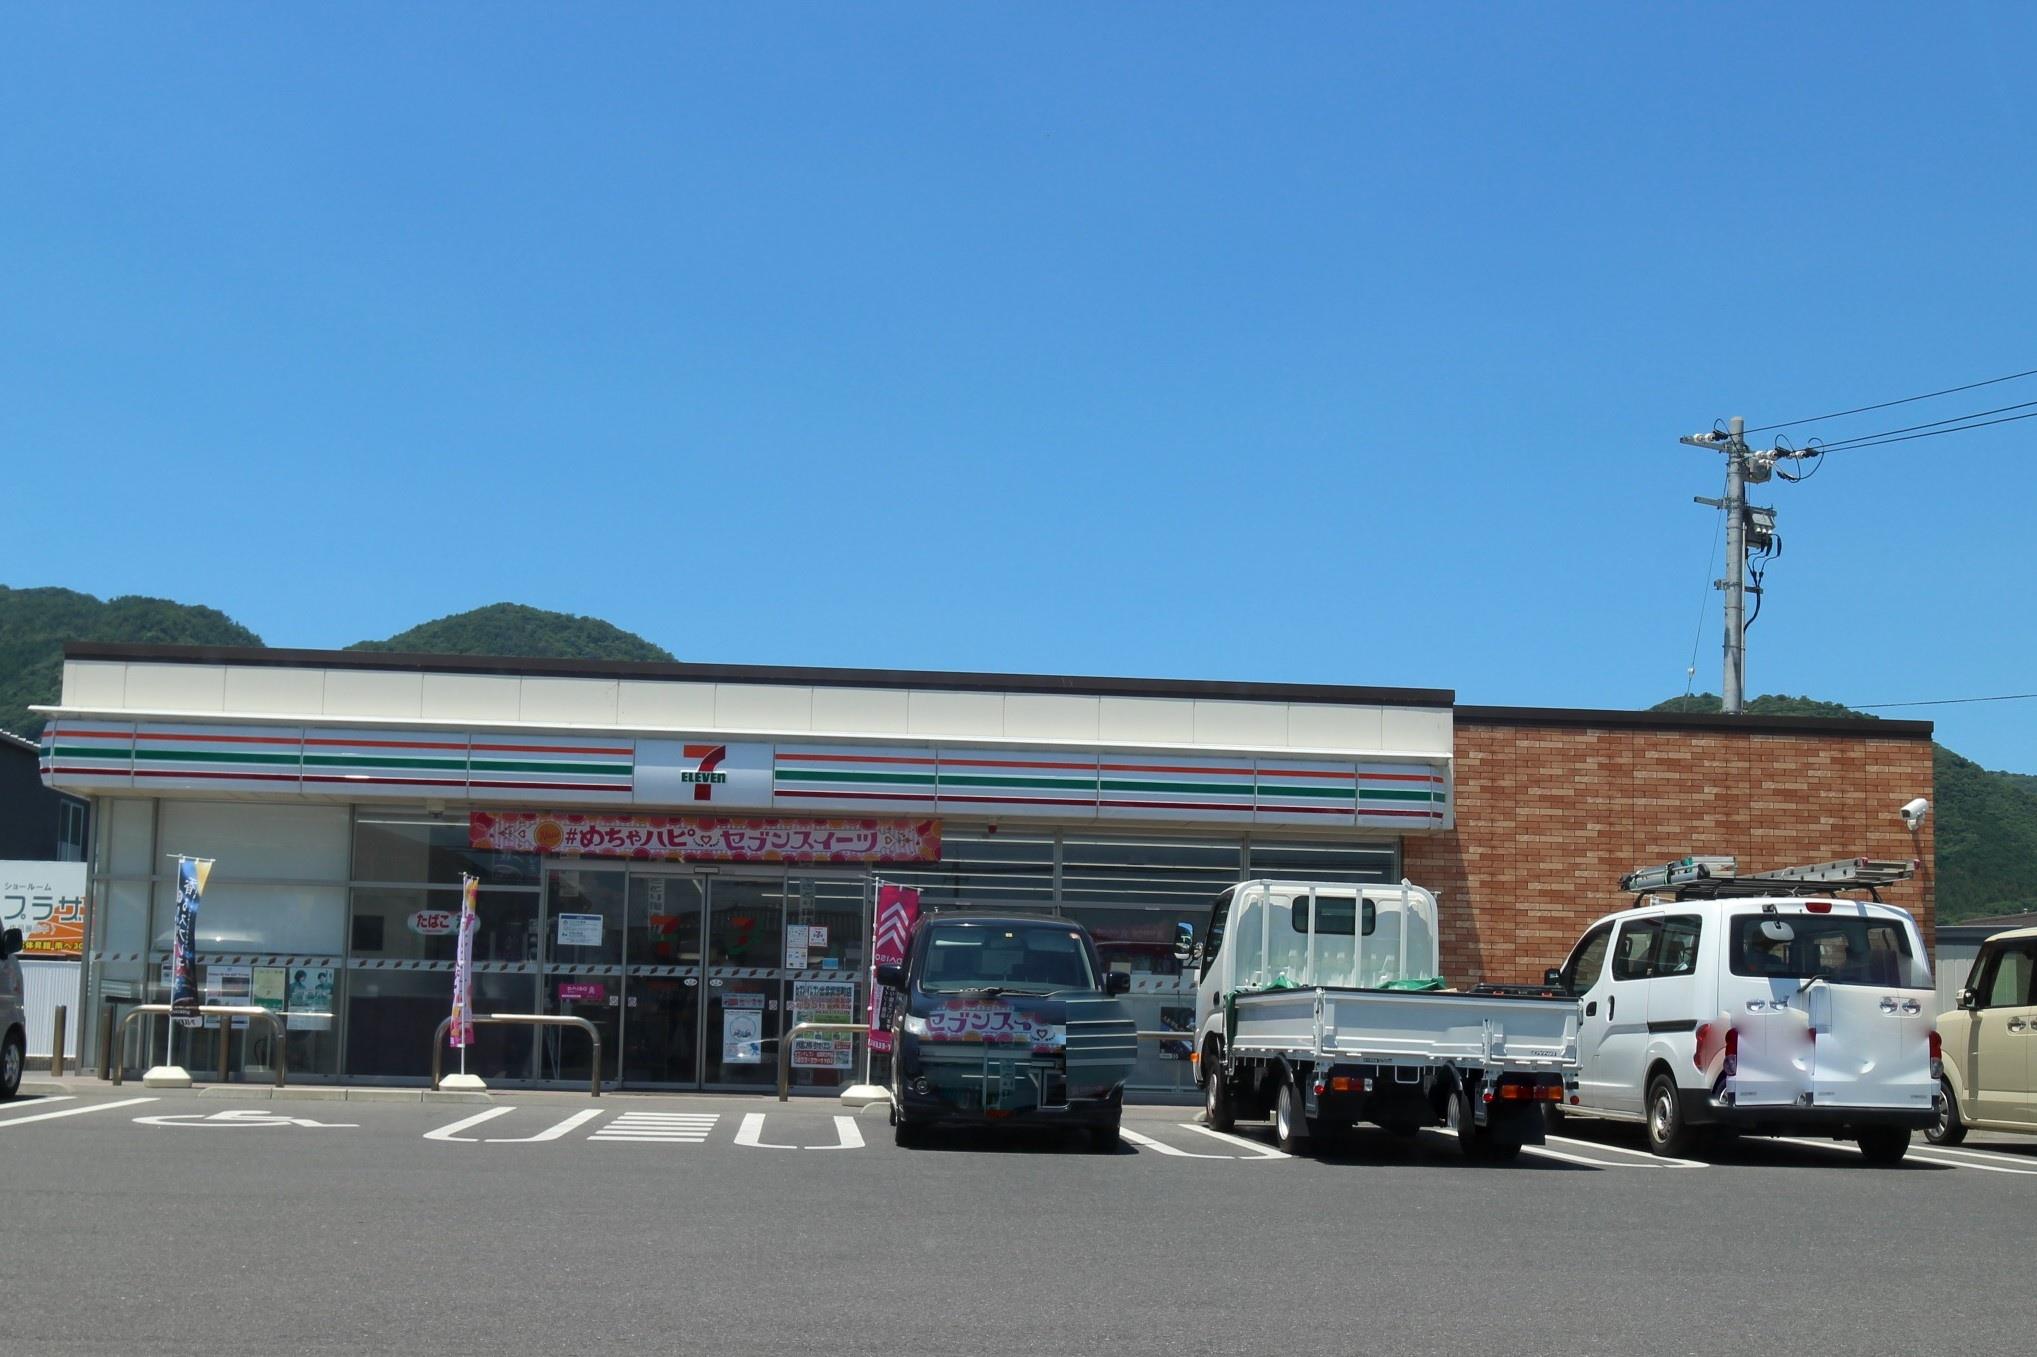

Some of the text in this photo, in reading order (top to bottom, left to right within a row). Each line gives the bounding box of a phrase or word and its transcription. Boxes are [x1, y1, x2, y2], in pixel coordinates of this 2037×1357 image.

[683, 744, 727, 801] 7
[565, 825, 878, 853] #めちゃハピ セブンスイーツ
[4, 882, 52, 891] ショールーム
[417, 913, 450, 929] たばこ
